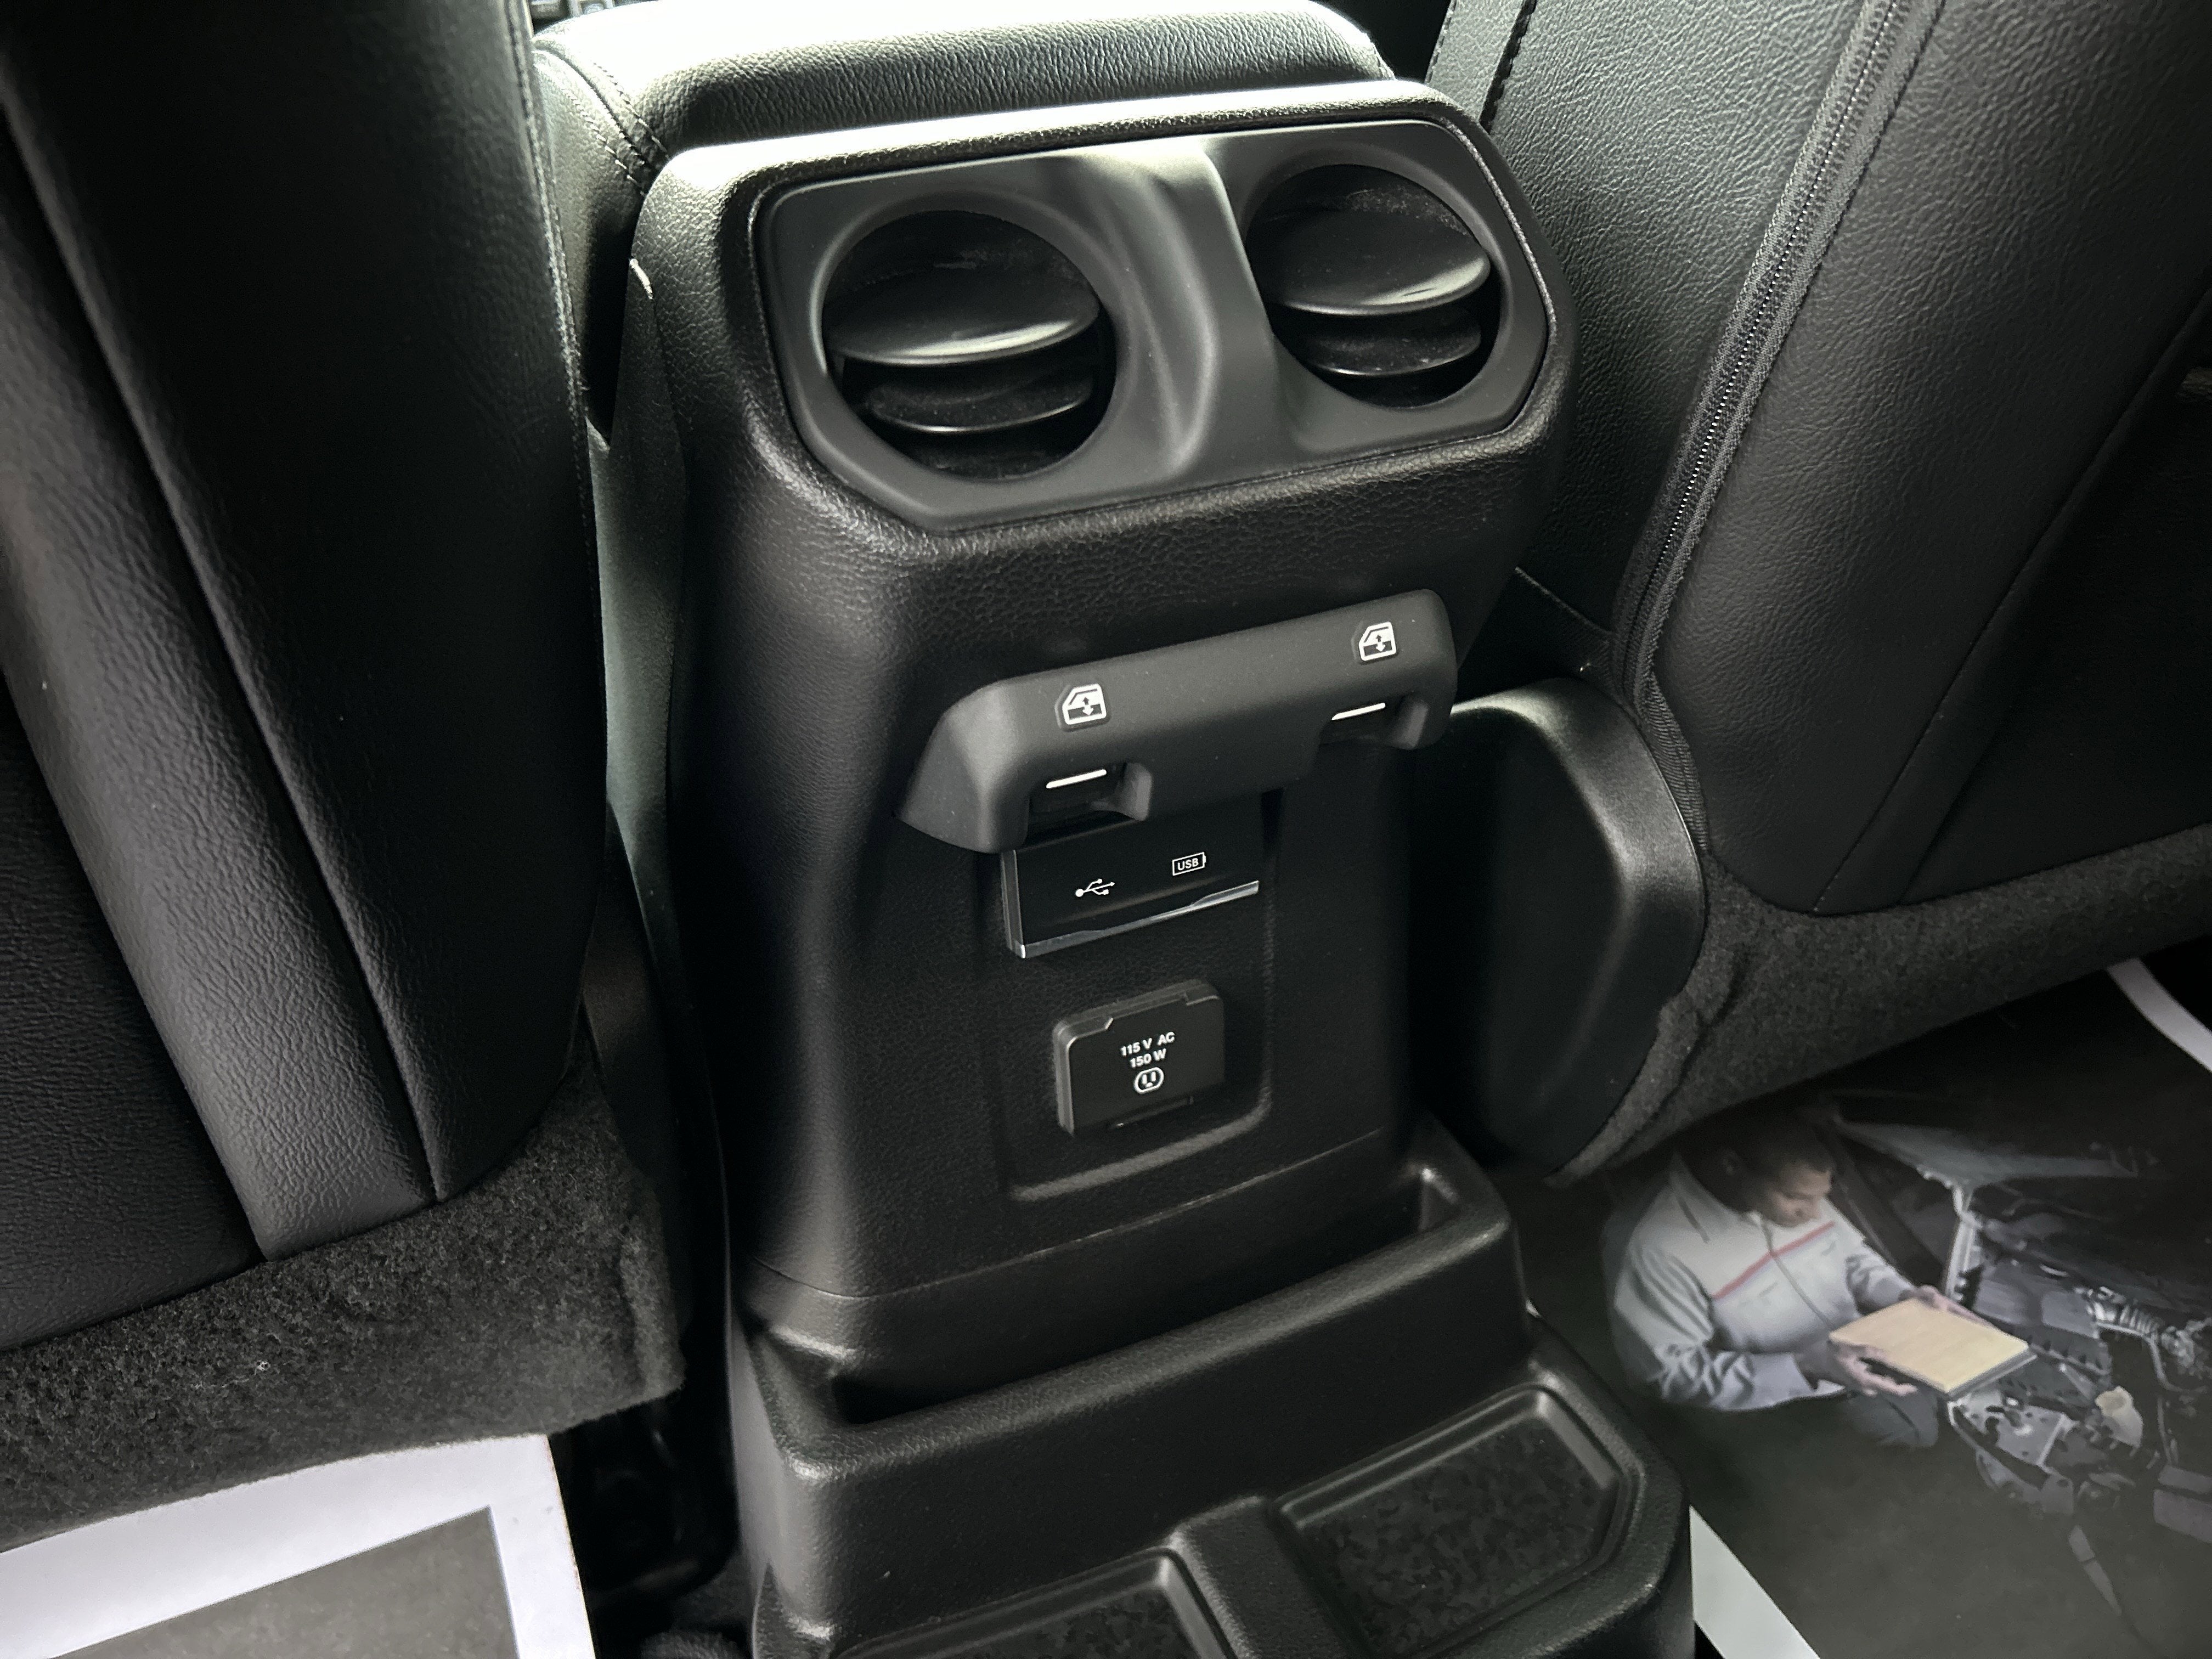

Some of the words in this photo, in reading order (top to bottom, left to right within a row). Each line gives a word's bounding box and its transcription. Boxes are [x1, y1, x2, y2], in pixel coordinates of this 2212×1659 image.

[1177, 858, 1199, 871] USB
[1120, 1042, 1141, 1057] 115
[1142, 1037, 1152, 1050] V
[1157, 1031, 1175, 1046] AC
[1130, 1053, 1152, 1069] 150
[1153, 1048, 1166, 1062] W
